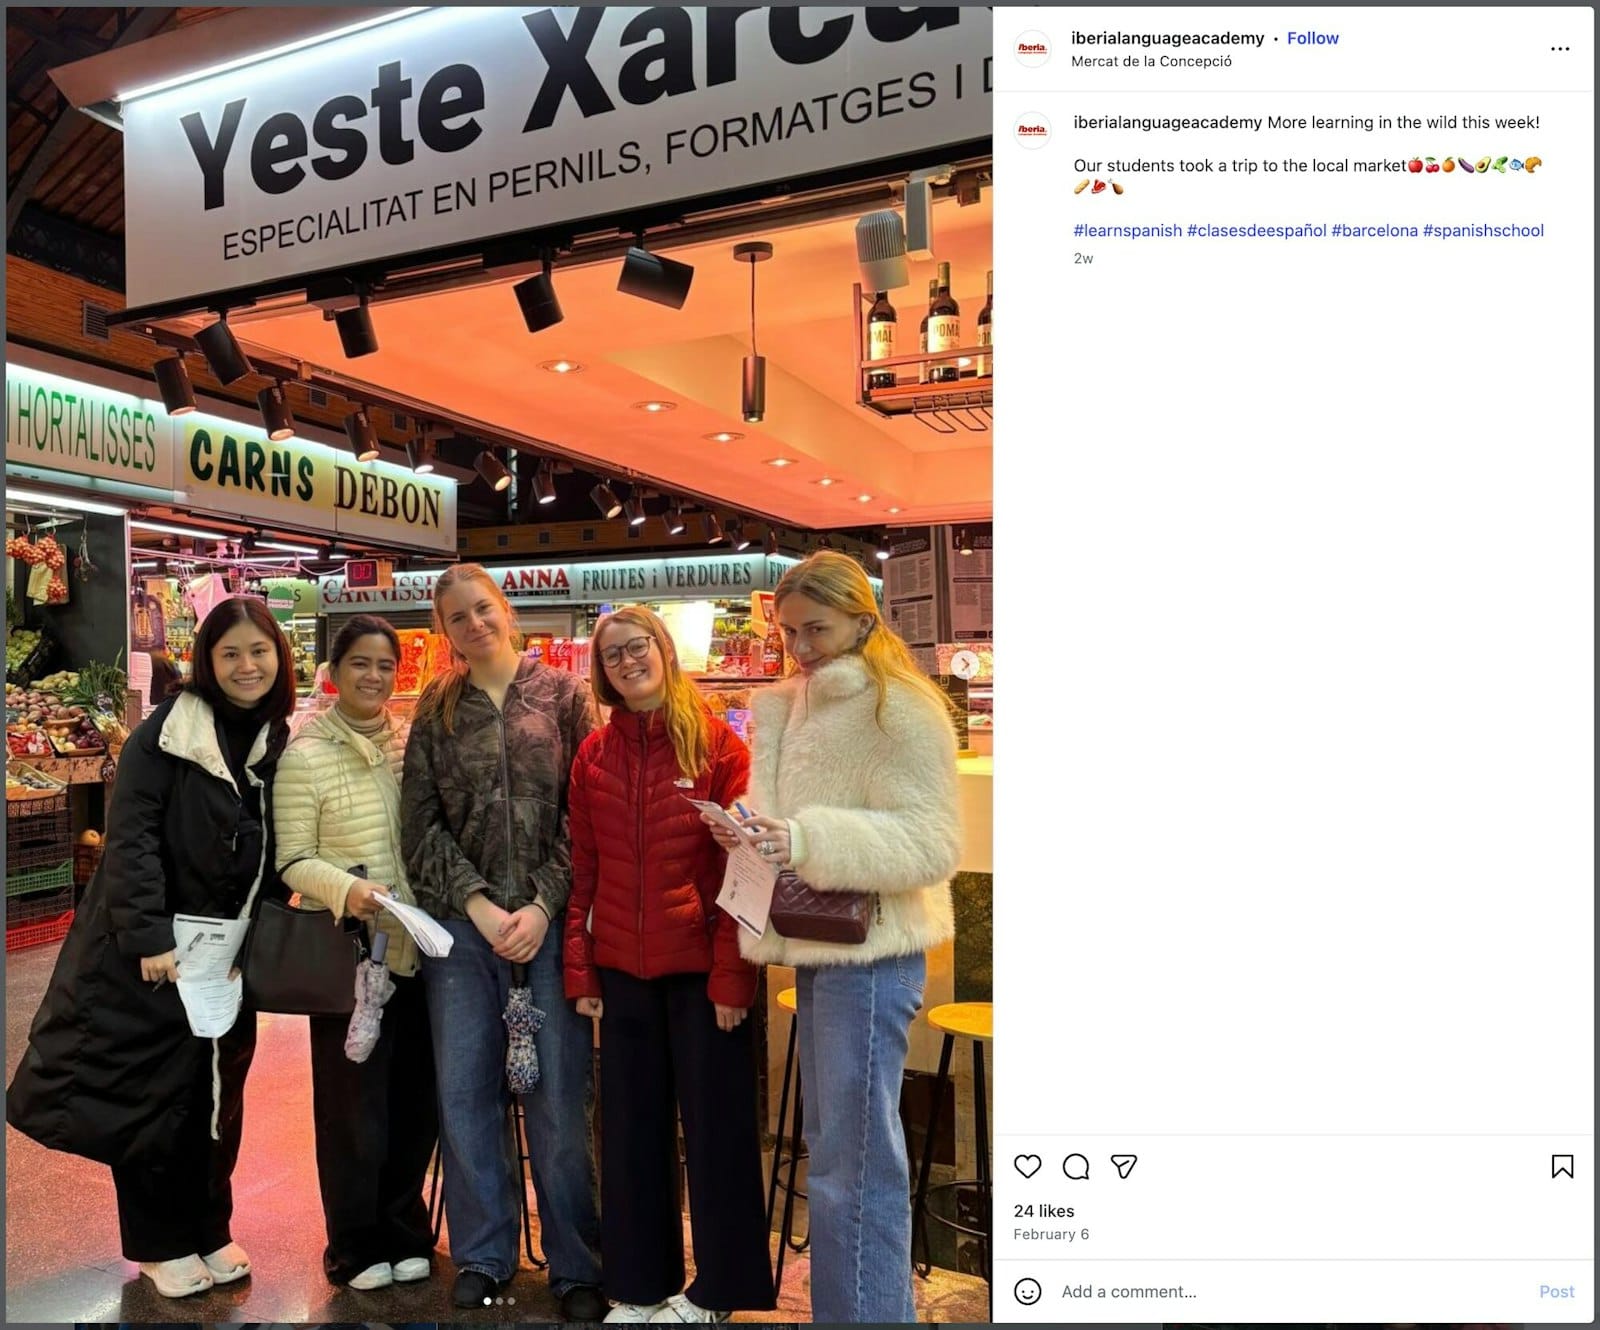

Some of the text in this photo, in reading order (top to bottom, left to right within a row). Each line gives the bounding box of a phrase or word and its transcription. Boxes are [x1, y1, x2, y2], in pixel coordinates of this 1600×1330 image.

[181, 7, 993, 212] Yeste Xarc
[224, 189, 423, 260] ESPECIALITAT
[434, 178, 476, 214] EN
[489, 141, 651, 202] PERNILS,
[667, 72, 936, 165] FORMATGES
[956, 64, 962, 99] I
[18, 383, 155, 472] HORTALISSES
[190, 429, 441, 529] CARNS DEBON
[502, 568, 570, 590] ANNA
[583, 562, 752, 591] FRUITES i VERDURES
